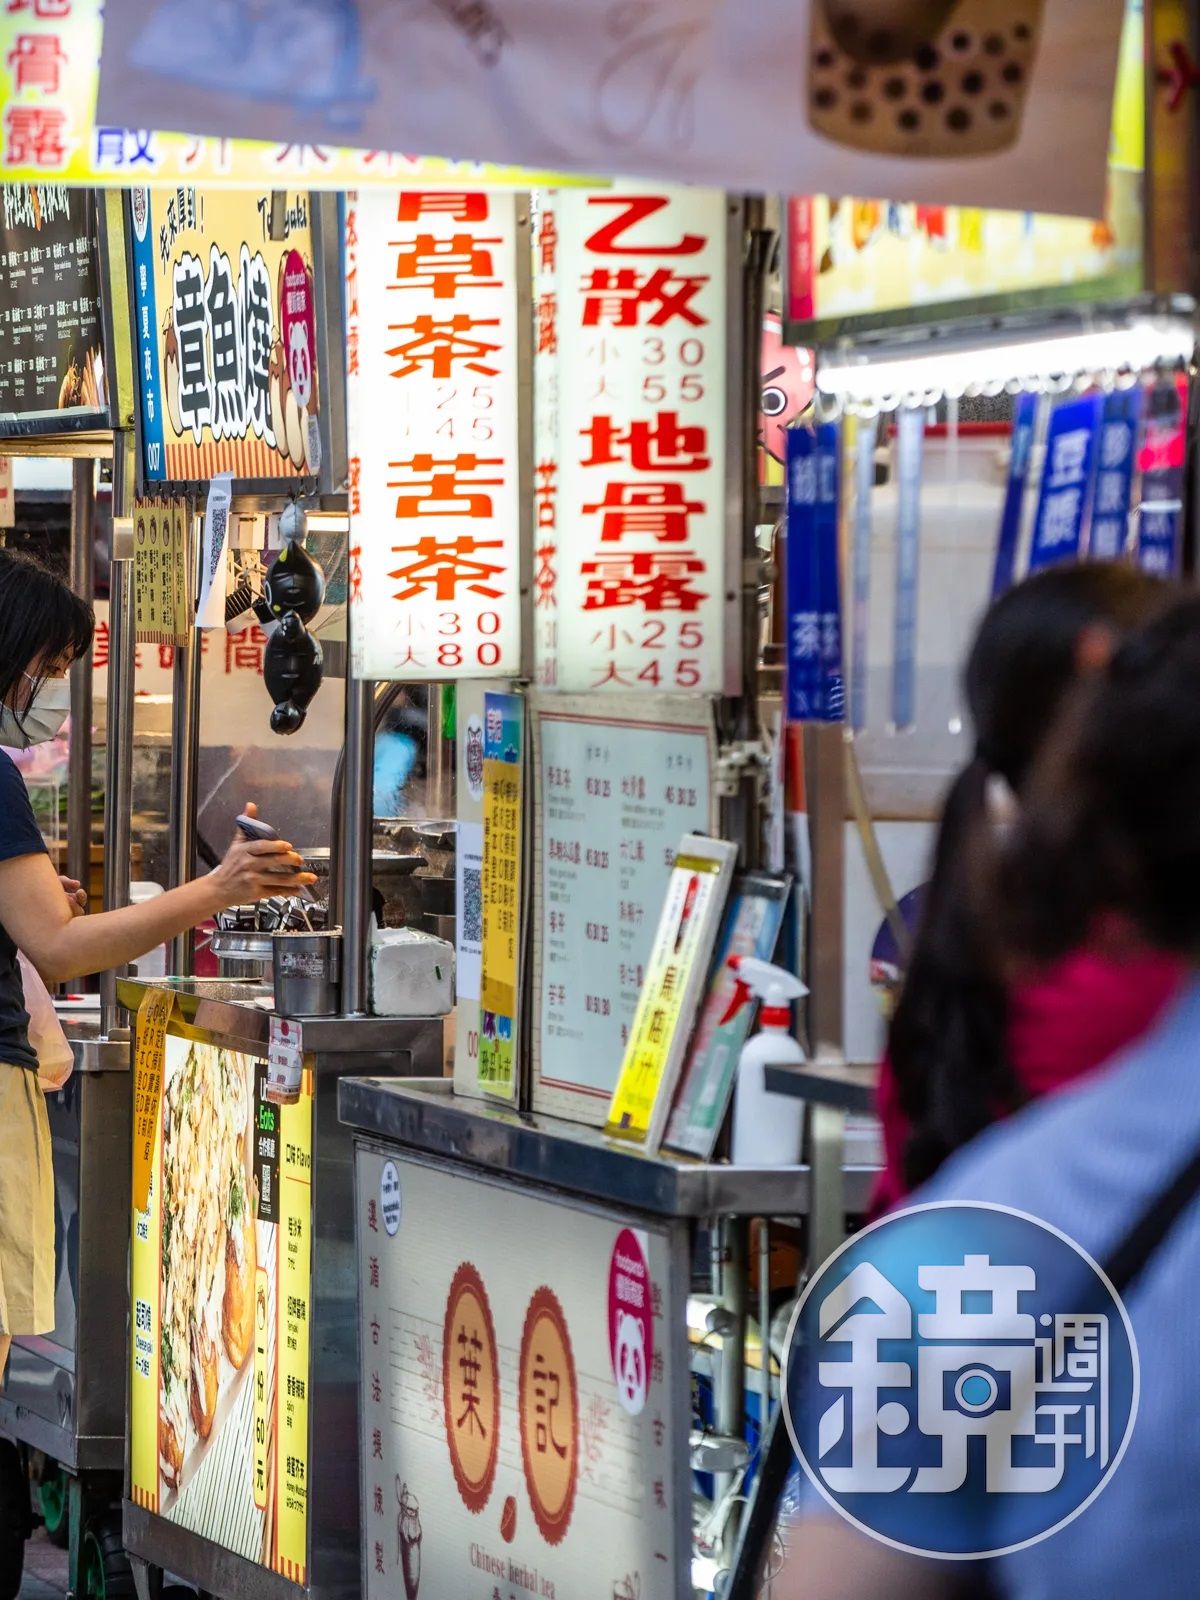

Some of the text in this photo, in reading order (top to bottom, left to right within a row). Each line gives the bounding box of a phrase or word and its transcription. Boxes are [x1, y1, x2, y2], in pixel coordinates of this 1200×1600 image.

[3, 0, 68, 168] 骨露
[174, 243, 276, 447] 章魚燒
[641, 338, 704, 366] 30
[641, 374, 704, 403] 55
[147, 443, 160, 472] 007
[386, 452, 506, 601] 苦茶
[579, 411, 712, 612] 地骨露
[436, 611, 501, 637] 30
[590, 621, 703, 652] 小 25
[436, 642, 501, 668] 80
[590, 660, 702, 690] 大 45
